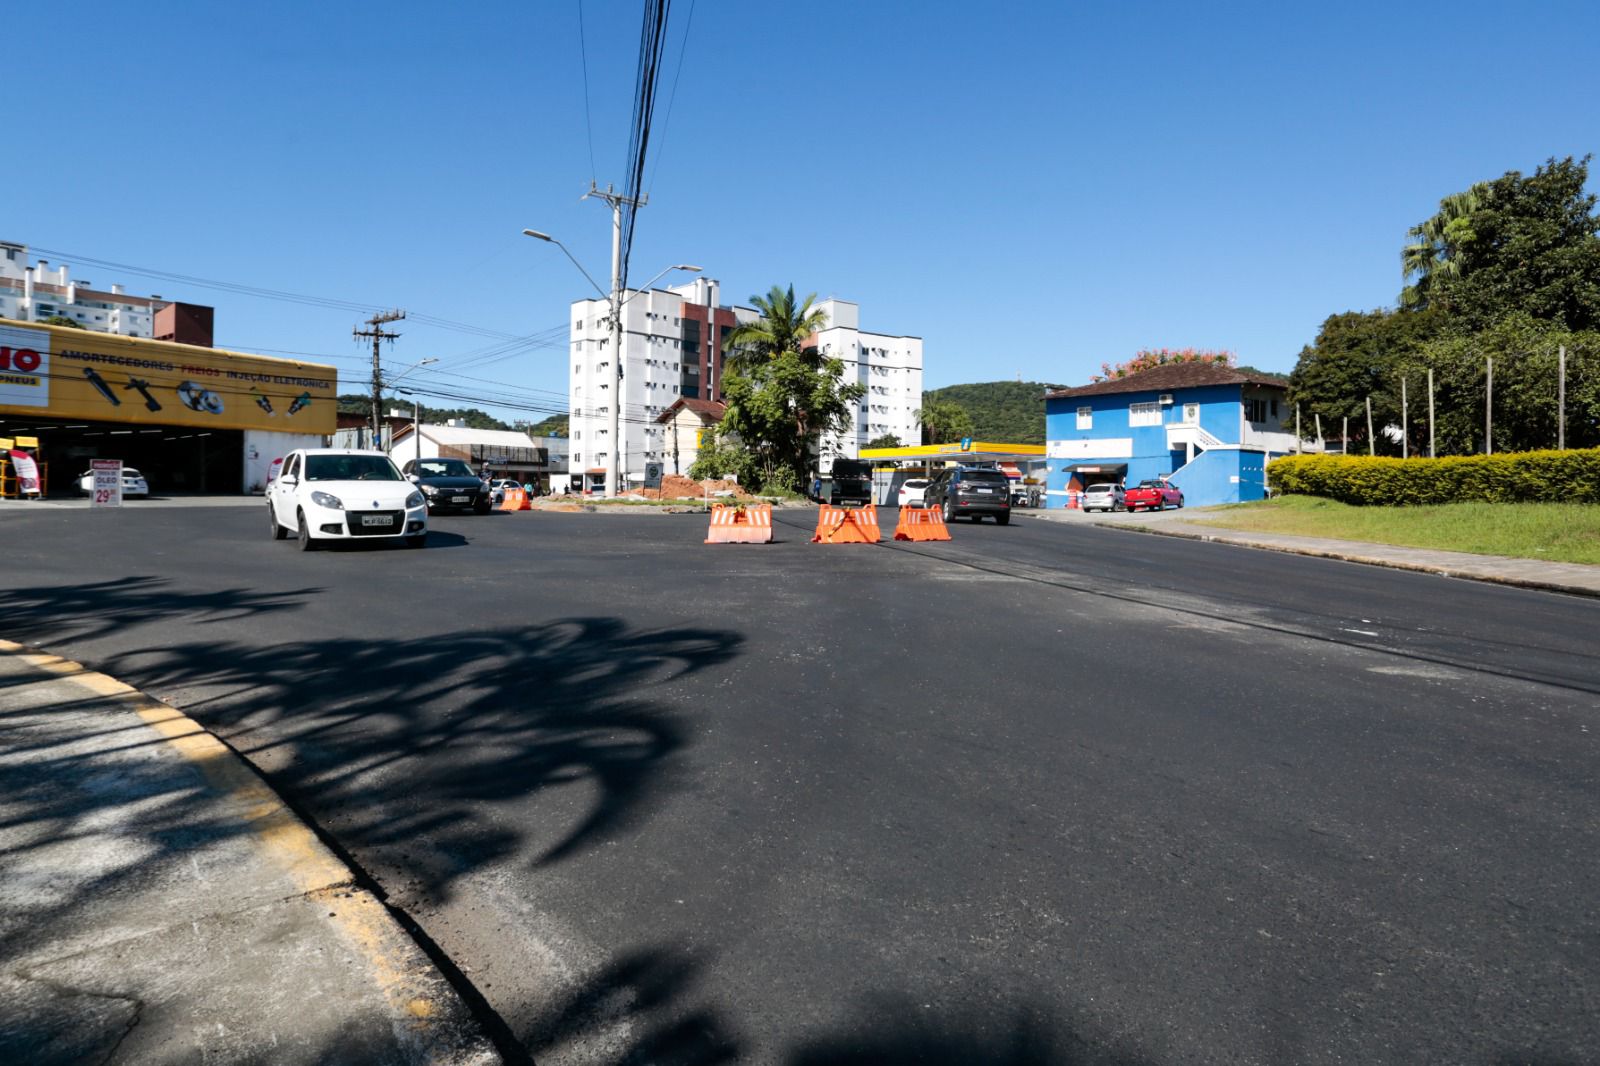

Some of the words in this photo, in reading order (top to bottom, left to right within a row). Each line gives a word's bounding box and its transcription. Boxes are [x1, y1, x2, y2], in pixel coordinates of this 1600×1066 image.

[60, 350, 174, 372] AMORTECEDORES
[181, 365, 220, 377] FREIOS
[96, 489, 110, 503] 29
